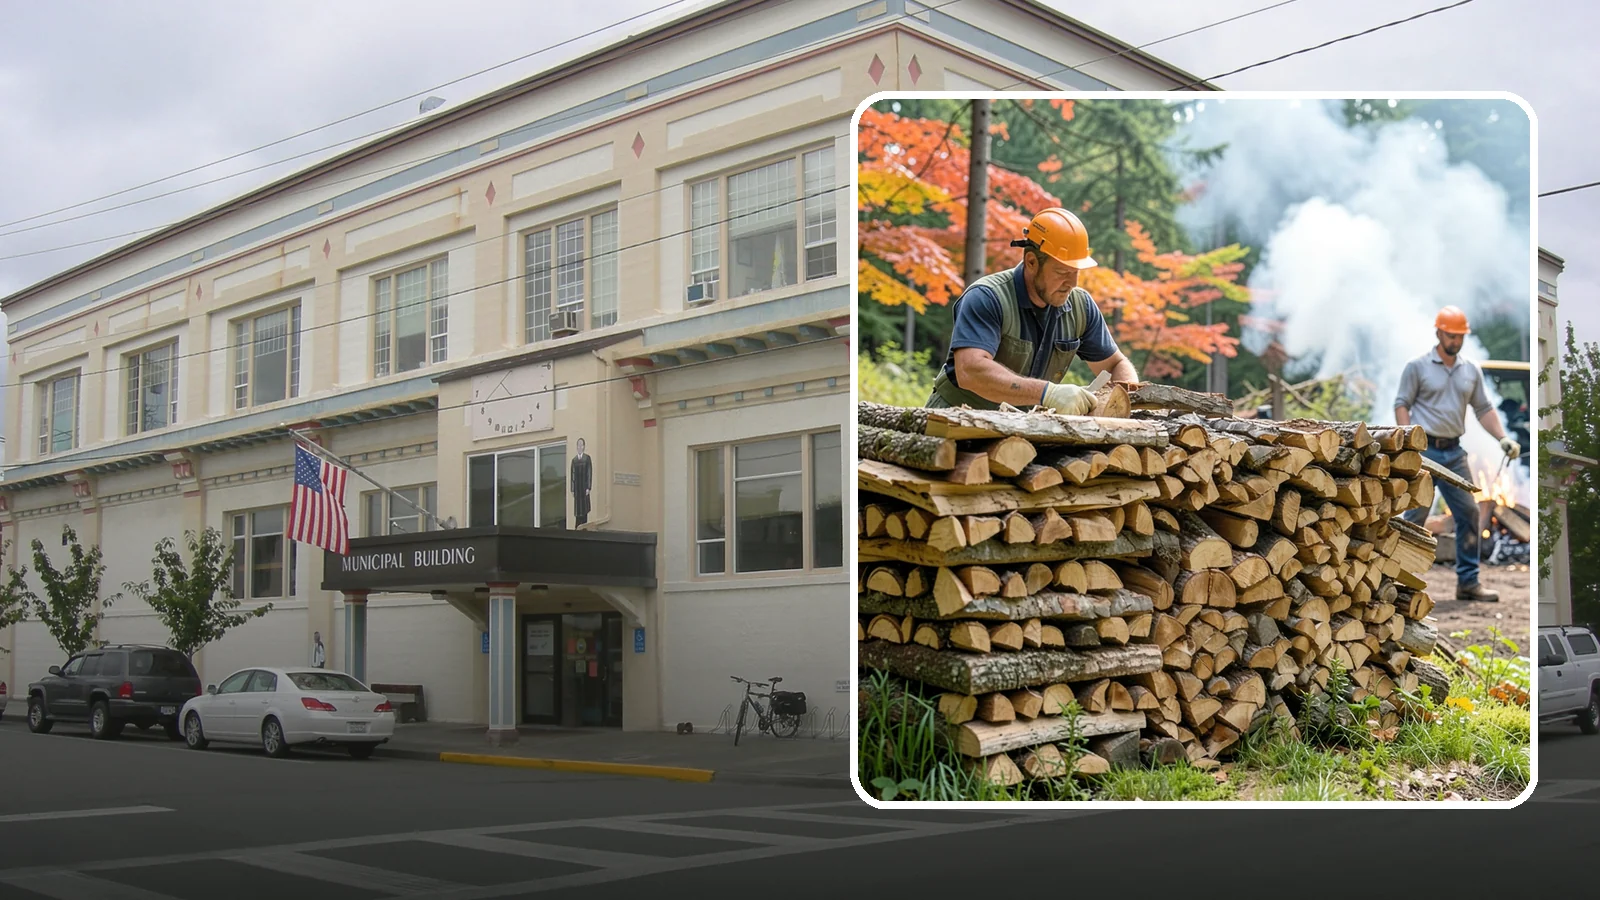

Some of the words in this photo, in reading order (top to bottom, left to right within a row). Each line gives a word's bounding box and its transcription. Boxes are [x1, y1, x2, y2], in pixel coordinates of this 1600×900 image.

[495, 424, 500, 432] 10
[508, 425, 513, 433] 12
[342, 552, 405, 572] MUNICIPAL
[414, 546, 475, 567] BUILDING
